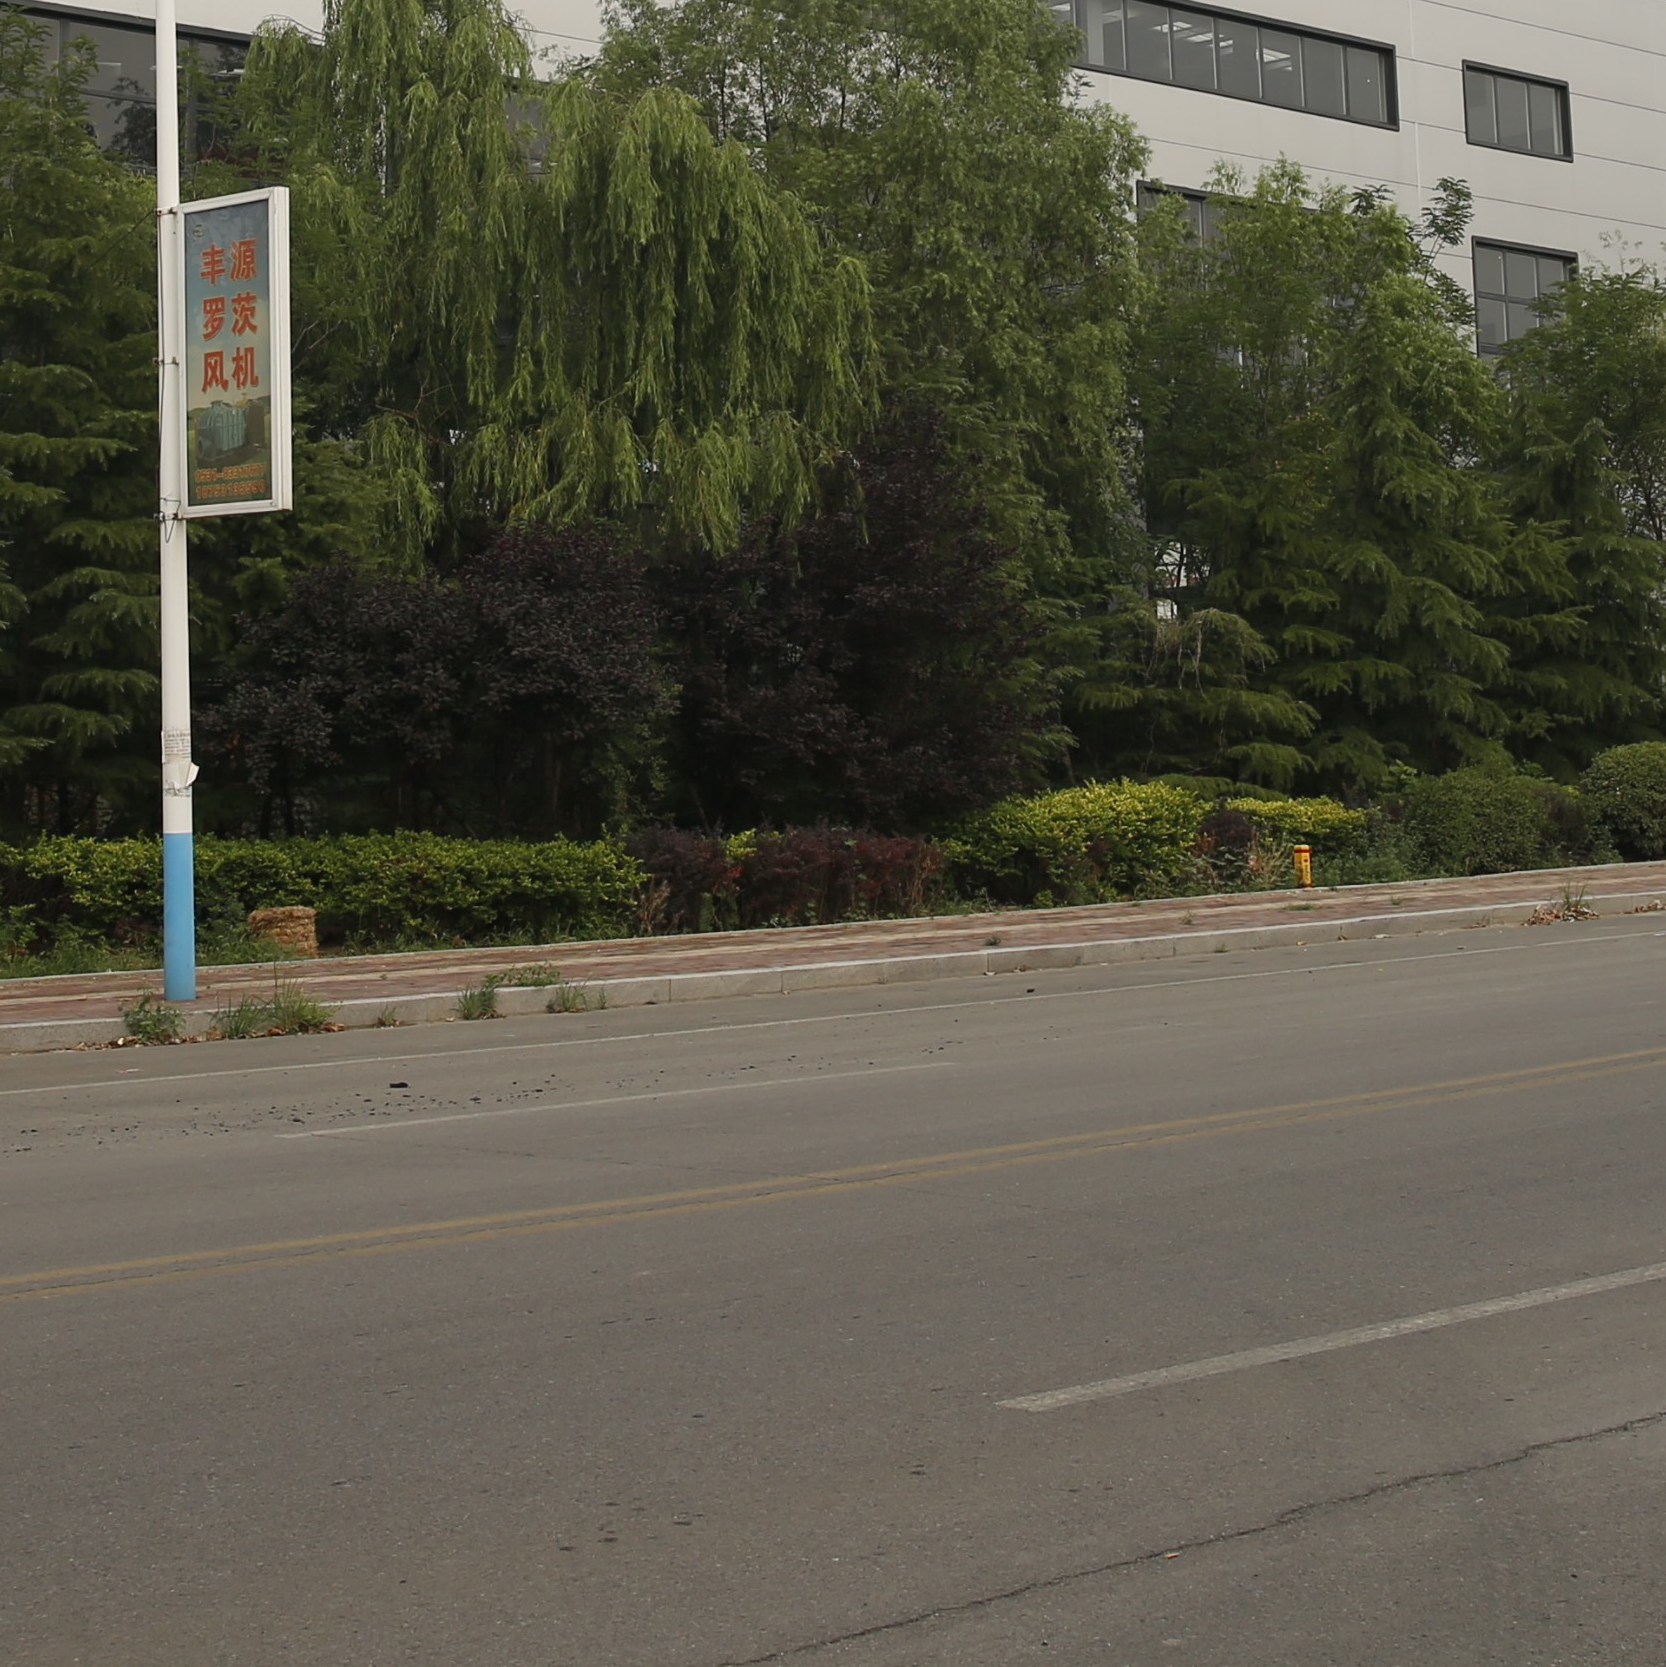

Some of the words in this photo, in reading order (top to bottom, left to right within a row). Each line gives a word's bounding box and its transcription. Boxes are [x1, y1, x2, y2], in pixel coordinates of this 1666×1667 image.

[200, 238, 258, 287] 丰源
[201, 293, 259, 341] 罗茨
[201, 346, 260, 394] 风机
